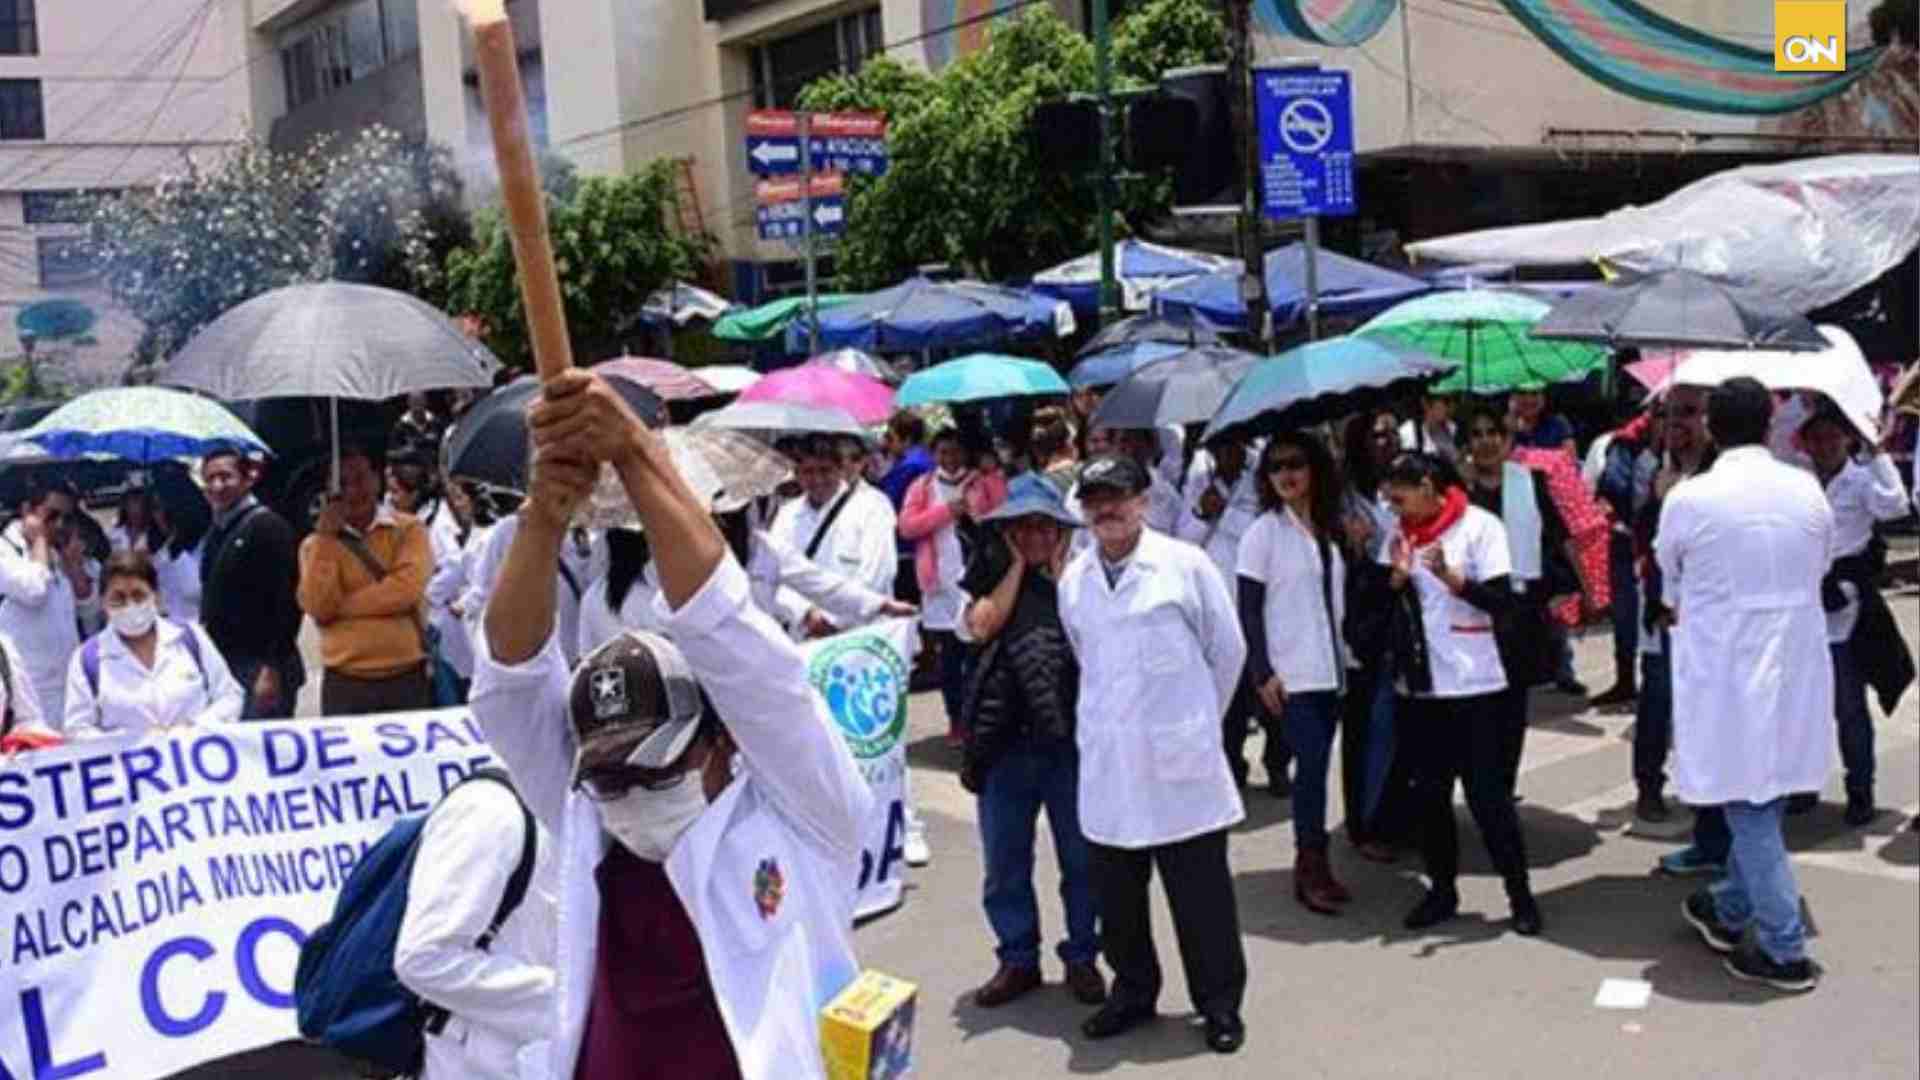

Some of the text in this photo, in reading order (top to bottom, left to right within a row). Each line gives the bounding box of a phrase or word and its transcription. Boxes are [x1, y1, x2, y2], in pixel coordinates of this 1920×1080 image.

[262, 727, 356, 778] DE
[44, 770, 429, 884] DEPARTAMENTAL
[13, 865, 203, 965] ALCALDIA
